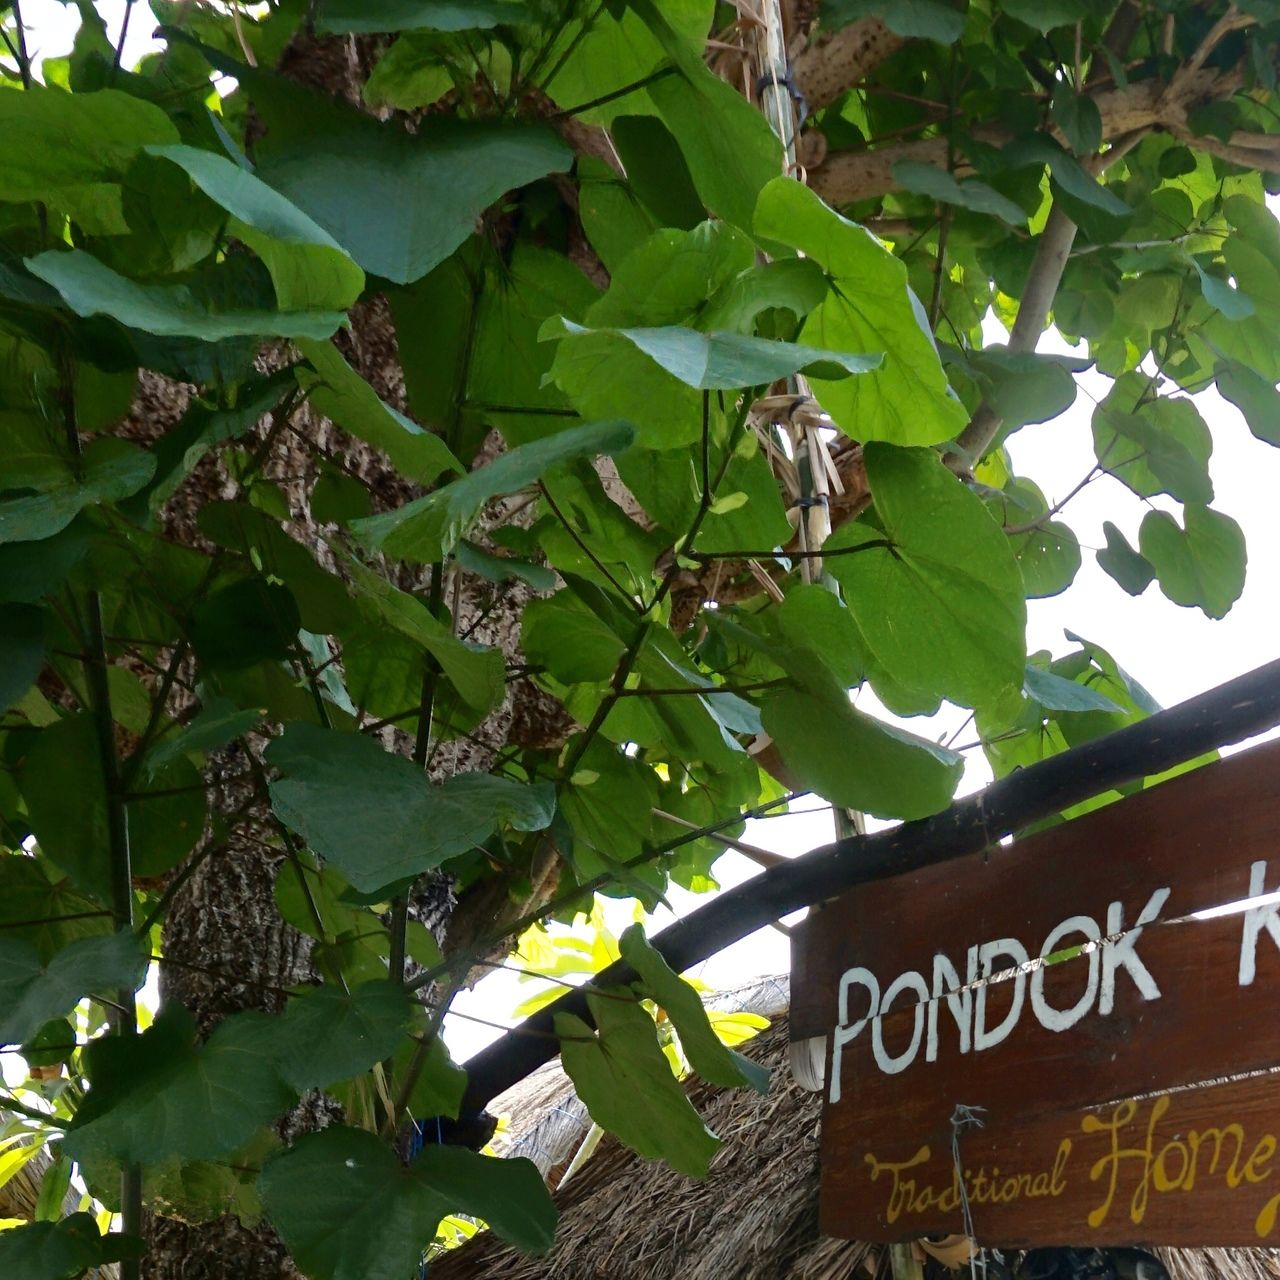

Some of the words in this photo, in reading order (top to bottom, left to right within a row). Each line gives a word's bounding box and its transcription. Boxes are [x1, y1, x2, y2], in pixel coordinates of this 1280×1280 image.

[829, 887, 1171, 1104] PONDOK
[864, 1138, 1072, 1224] Traditional
[1081, 1095, 1277, 1228] Home
